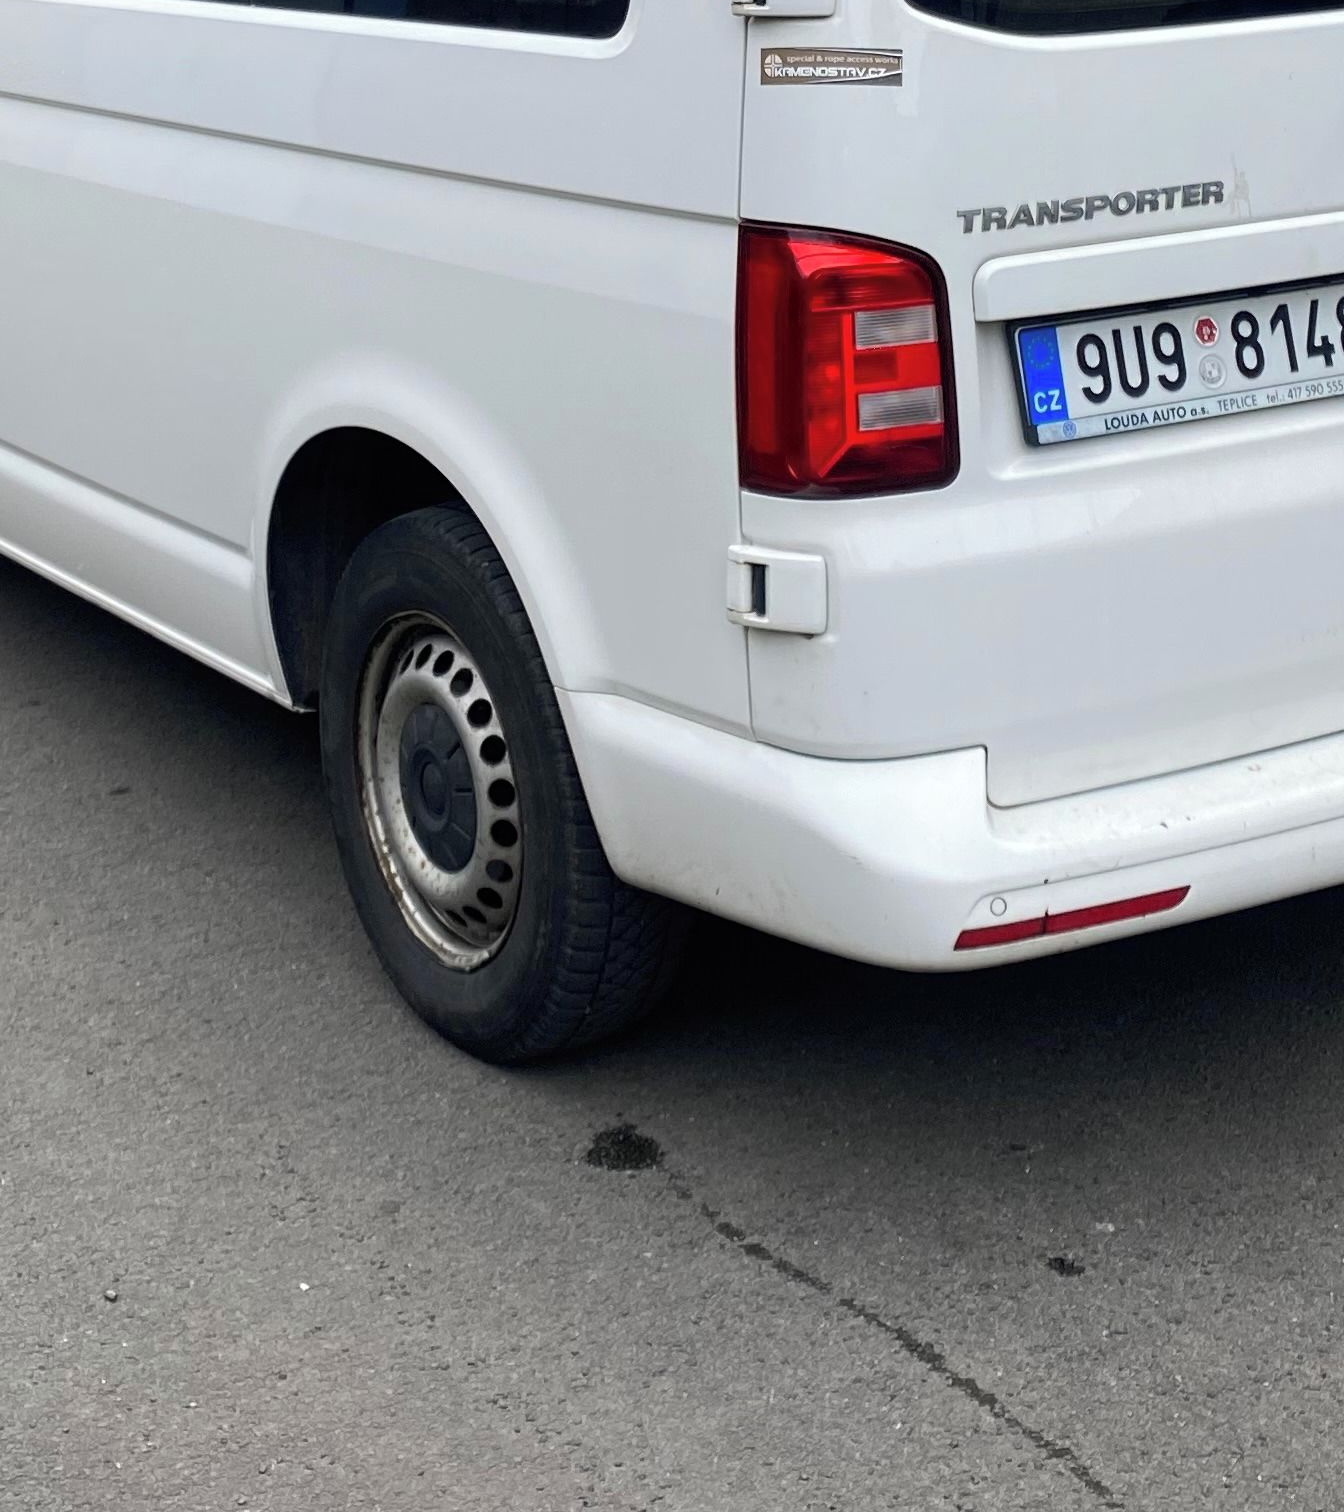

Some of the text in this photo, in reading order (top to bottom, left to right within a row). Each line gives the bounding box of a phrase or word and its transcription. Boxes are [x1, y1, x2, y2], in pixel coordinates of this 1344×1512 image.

[786, 54, 899, 65] special & rope access works
[956, 180, 1225, 234] TRANSPORTER
[1075, 321, 1188, 404] 9U9
[1033, 389, 1063, 414] CZ
[1104, 411, 1149, 431] LOUDA
[1152, 405, 1187, 424] AUTO
[1216, 394, 1258, 413] TEPLICE
[1287, 386, 1302, 402] 417
[1305, 382, 1324, 397] 590
[1326, 379, 1344, 393] 555
